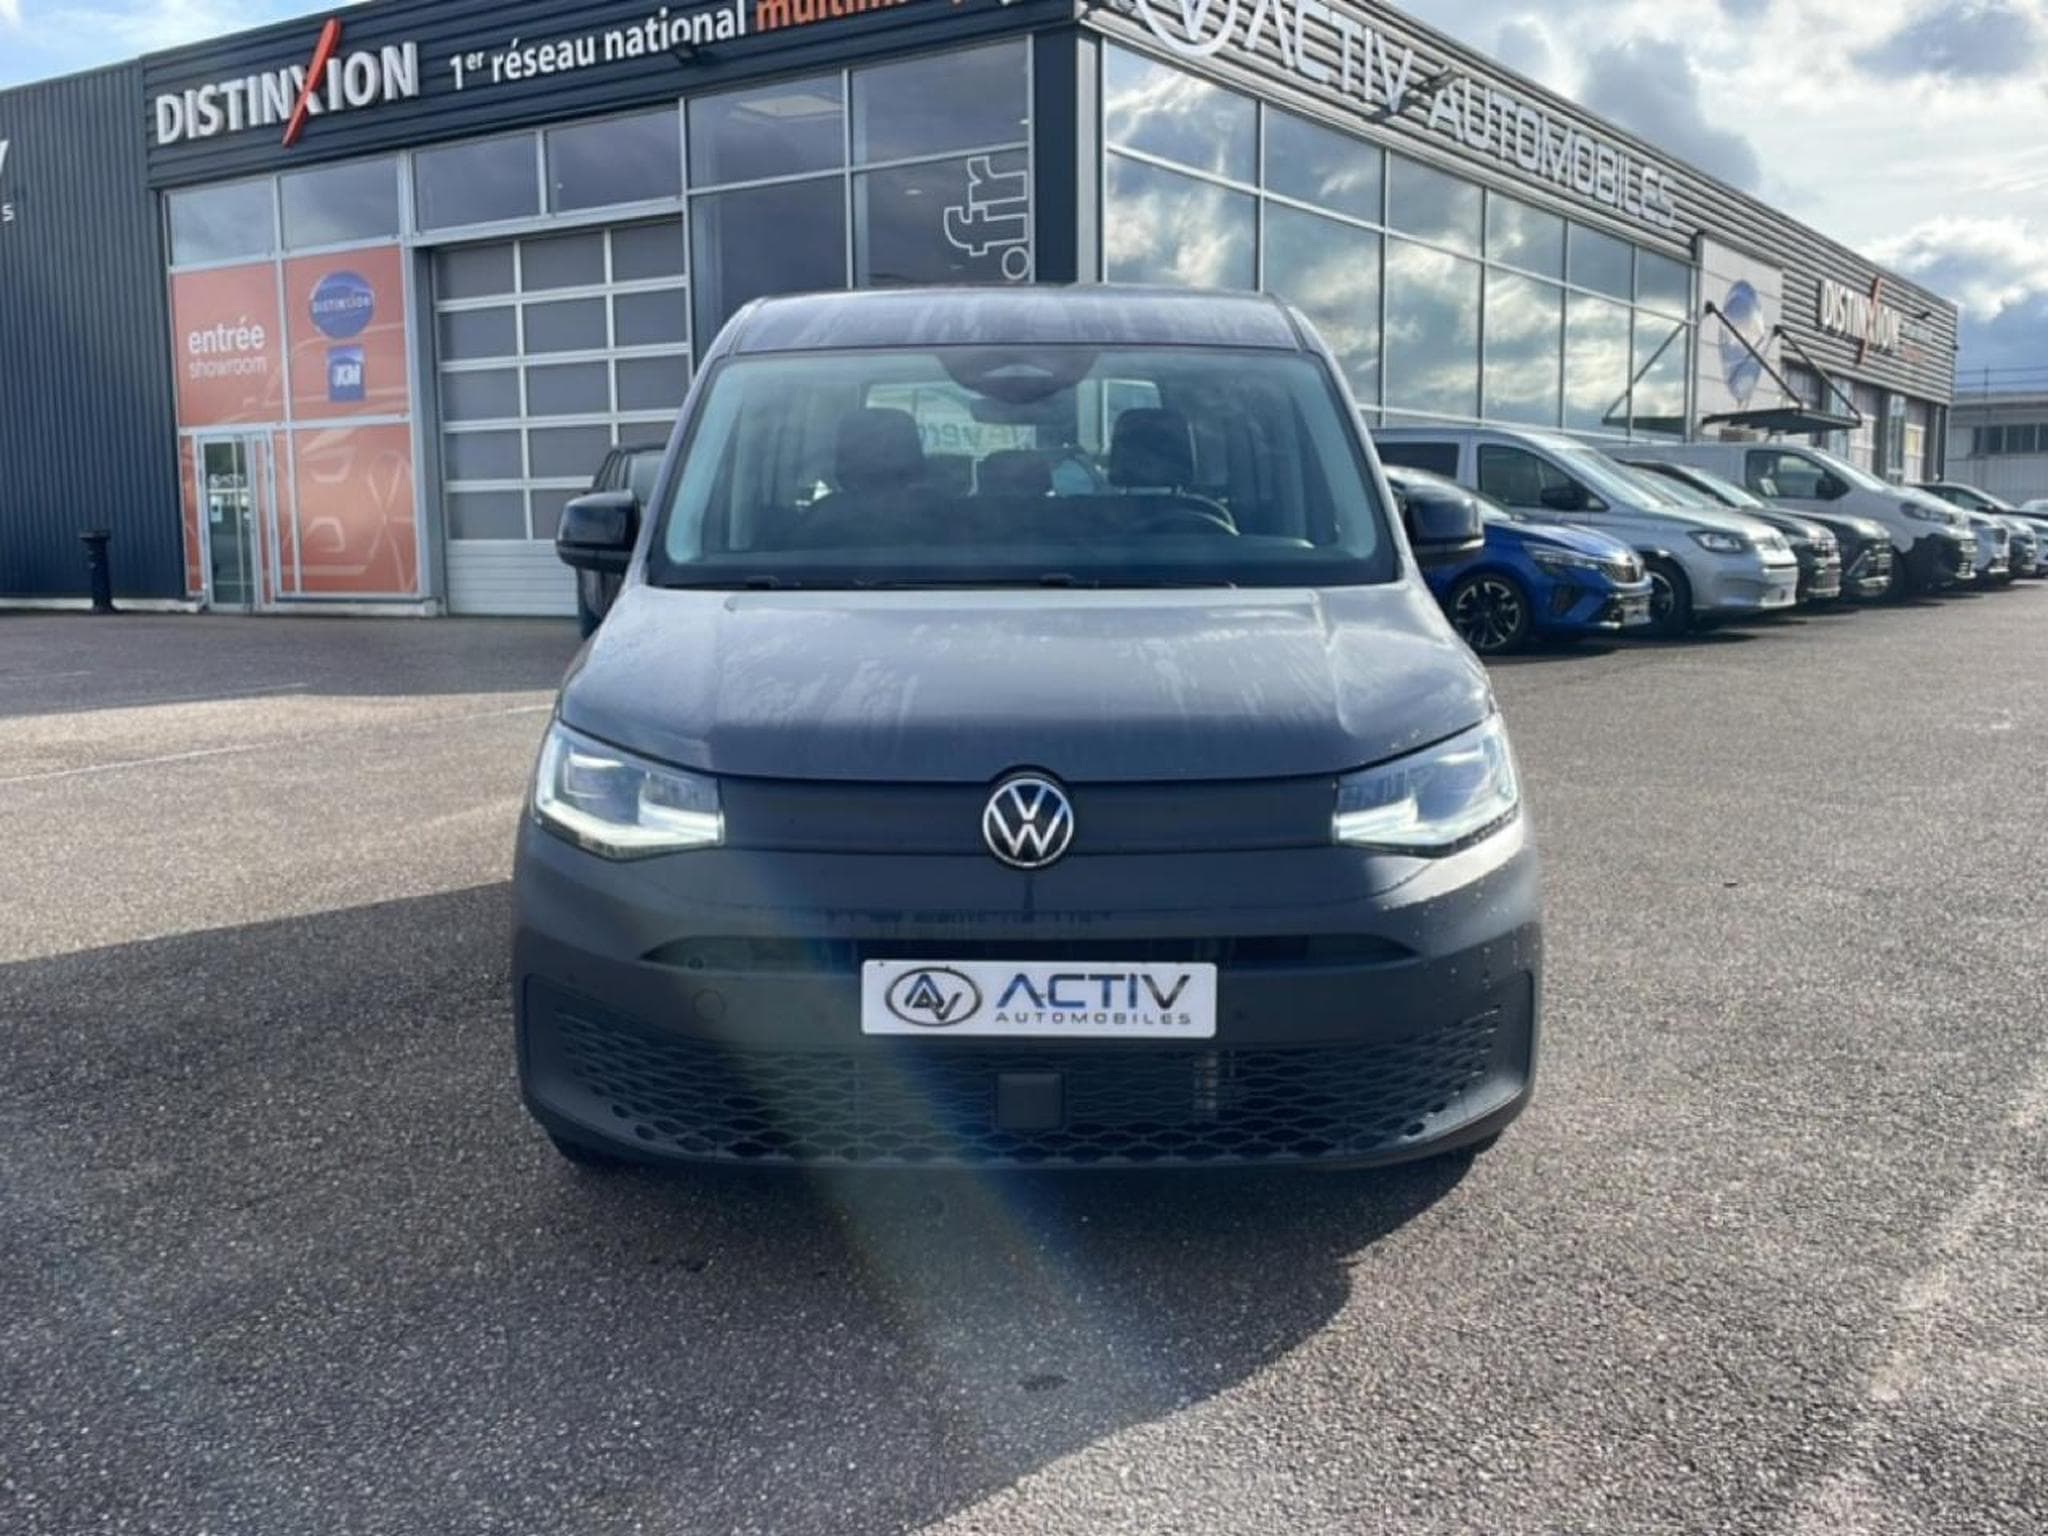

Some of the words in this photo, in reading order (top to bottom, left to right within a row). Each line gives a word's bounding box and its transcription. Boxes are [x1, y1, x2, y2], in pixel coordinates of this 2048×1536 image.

[490, 37, 596, 83] réseau
[604, 0, 747, 61] national
[156, 16, 420, 149] DISTINXION
[1244, 0, 1414, 114] ACTIV
[1428, 77, 1675, 229] AUTOMOBILES
[187, 316, 266, 355] entrée
[188, 356, 267, 380] showroom
[995, 972, 1191, 1010] ACTIV
[994, 1011, 1192, 1026] AUTOMOBILES
